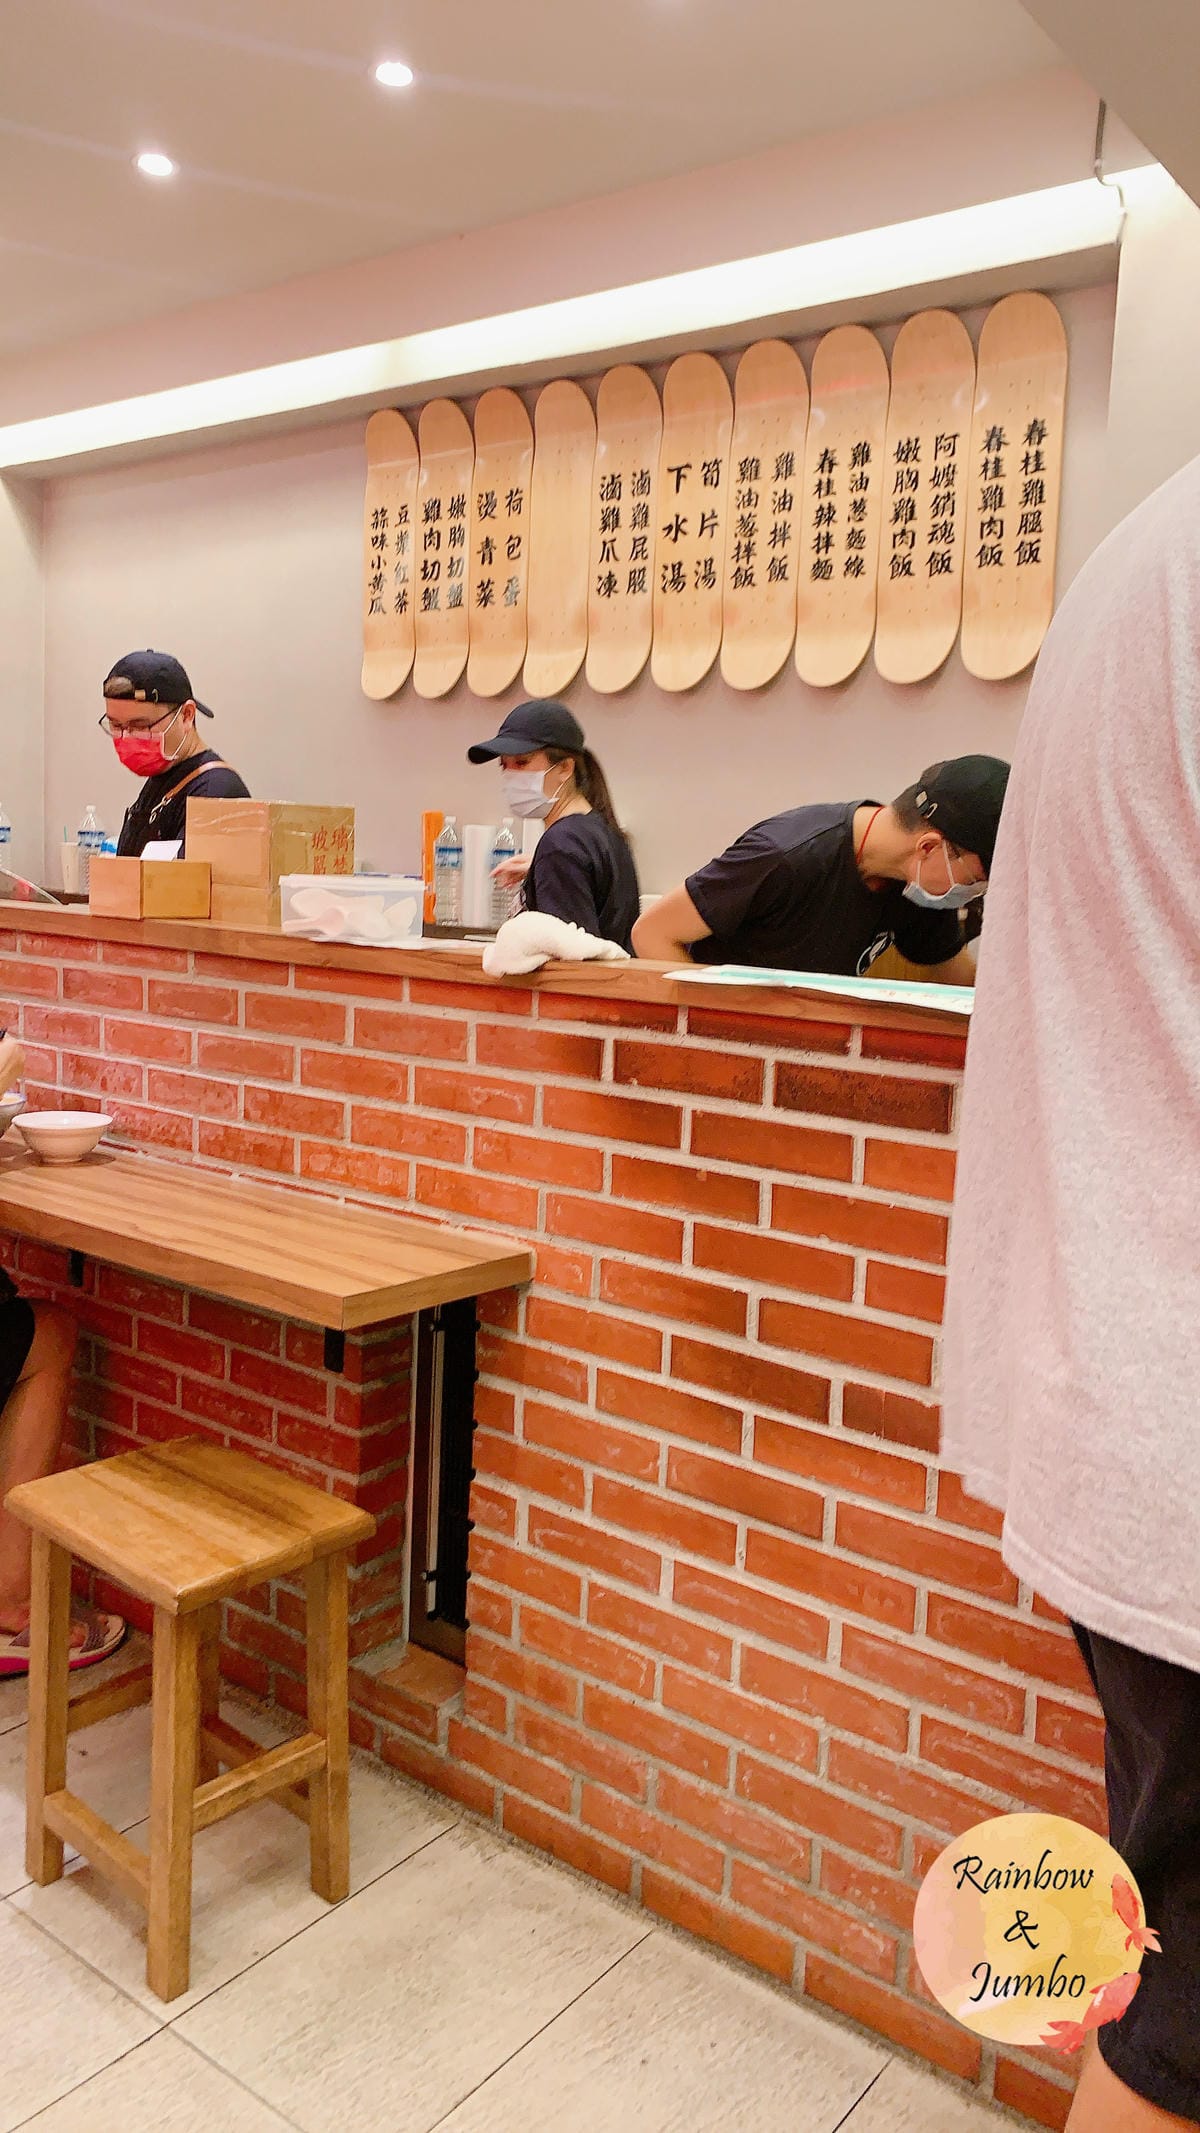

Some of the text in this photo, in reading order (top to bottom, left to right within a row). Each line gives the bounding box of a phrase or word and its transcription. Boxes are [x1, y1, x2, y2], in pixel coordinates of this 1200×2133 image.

[476, 489, 498, 610] 燙青菜
[502, 486, 525, 609] 荷包蛋
[596, 472, 622, 599] 滷雞爪凍
[626, 468, 651, 596] 滷雞屁股
[660, 461, 693, 595] 下水湯
[693, 457, 723, 590] 筍片湯
[766, 450, 797, 584] 雞油拌飯
[888, 436, 923, 581] 嫩胸雞肉飯
